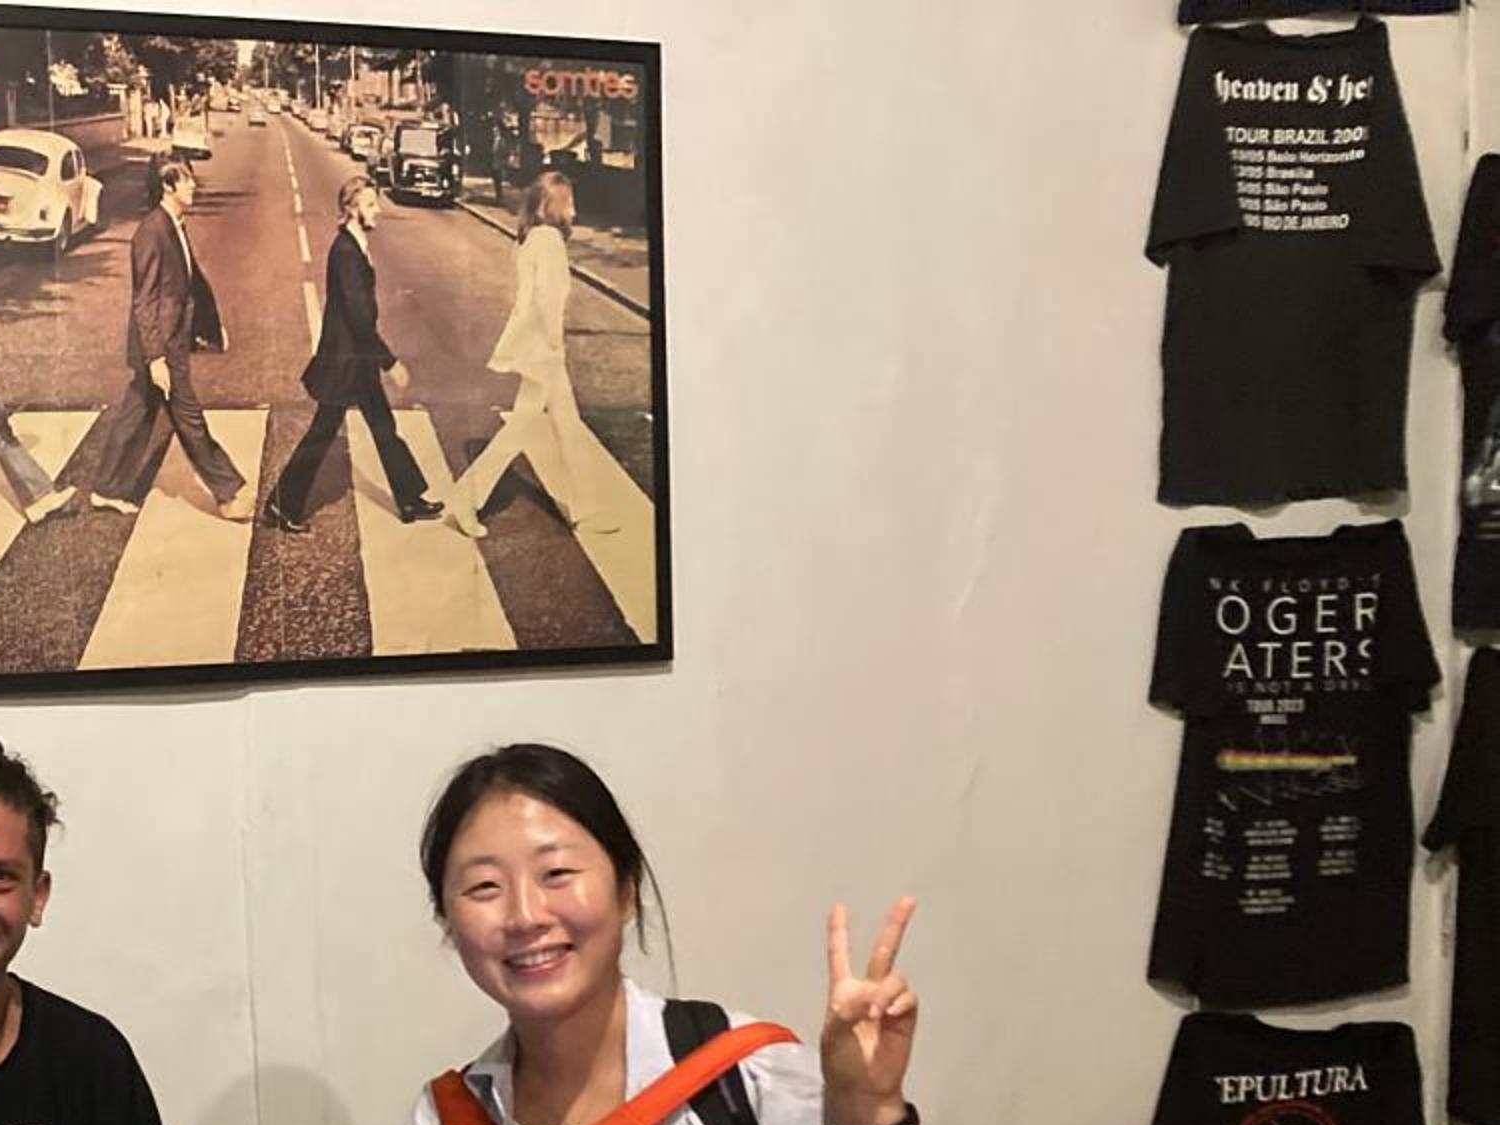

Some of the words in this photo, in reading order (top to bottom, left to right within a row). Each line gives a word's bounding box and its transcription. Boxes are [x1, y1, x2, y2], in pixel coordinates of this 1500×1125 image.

[1215, 71, 1299, 103] heaven
[1225, 126, 1269, 143] TOUR
[1273, 128, 1329, 145] BRAZIL
[1332, 126, 1370, 145] 200
[1217, 592, 1378, 635] OGER
[1222, 638, 1372, 679] ATERS
[1216, 1064, 1369, 1103] EPULTURA
